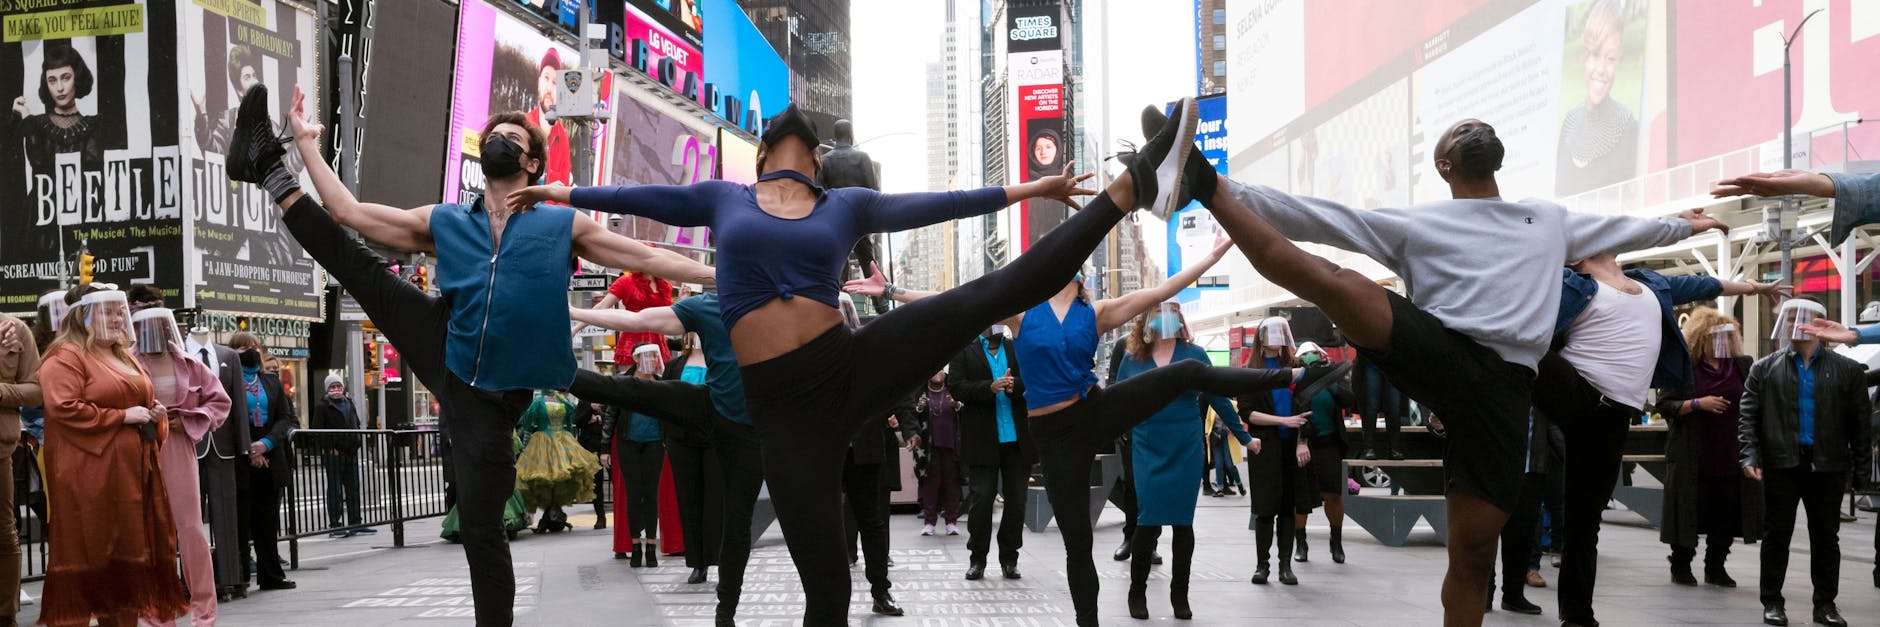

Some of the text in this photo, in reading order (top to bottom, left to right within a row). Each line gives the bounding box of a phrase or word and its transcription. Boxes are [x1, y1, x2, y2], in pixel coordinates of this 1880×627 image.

[8, 9, 140, 37] MAKE YOU FEEL ALIVE!
[1016, 17, 1051, 28] TIMES
[237, 24, 294, 59] ON BROADWAY!
[1012, 27, 1056, 39] SQUARE
[648, 29, 660, 50] LG
[660, 37, 690, 67] VELVET
[35, 152, 180, 226] BEETLE
[73, 229, 89, 241] The
[129, 226, 146, 238] The
[111, 256, 139, 273] FUN!"
[214, 262, 270, 281] JAW-DROPPING
[587, 279, 602, 287] WAY
[249, 317, 311, 338] LUGGAGE
[267, 347, 290, 356] SONY
